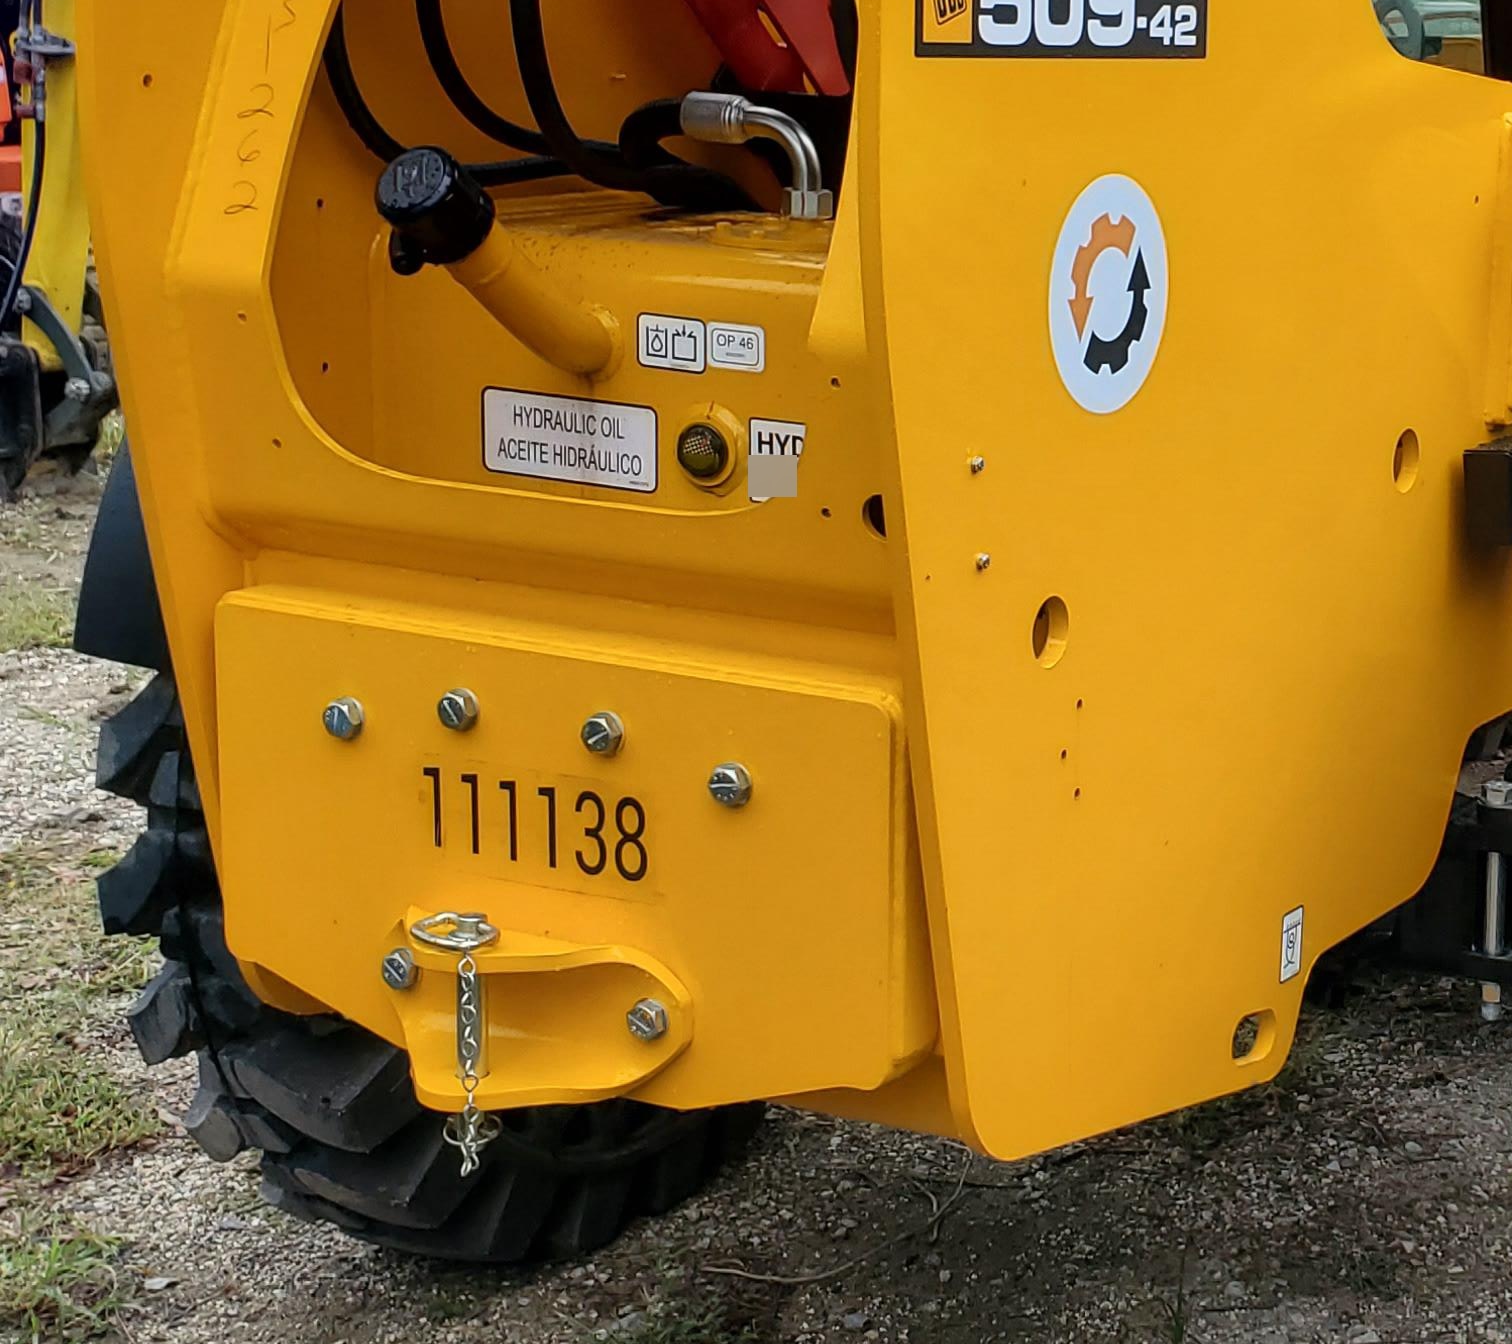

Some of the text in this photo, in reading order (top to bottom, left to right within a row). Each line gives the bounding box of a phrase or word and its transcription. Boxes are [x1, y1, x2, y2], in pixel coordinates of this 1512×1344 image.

[716, 333, 754, 350] OP 46
[514, 404, 625, 440] HYDRAULIC OIL
[497, 437, 642, 477] ACEITE HIDRÁULICO
[423, 767, 648, 882] 111138
